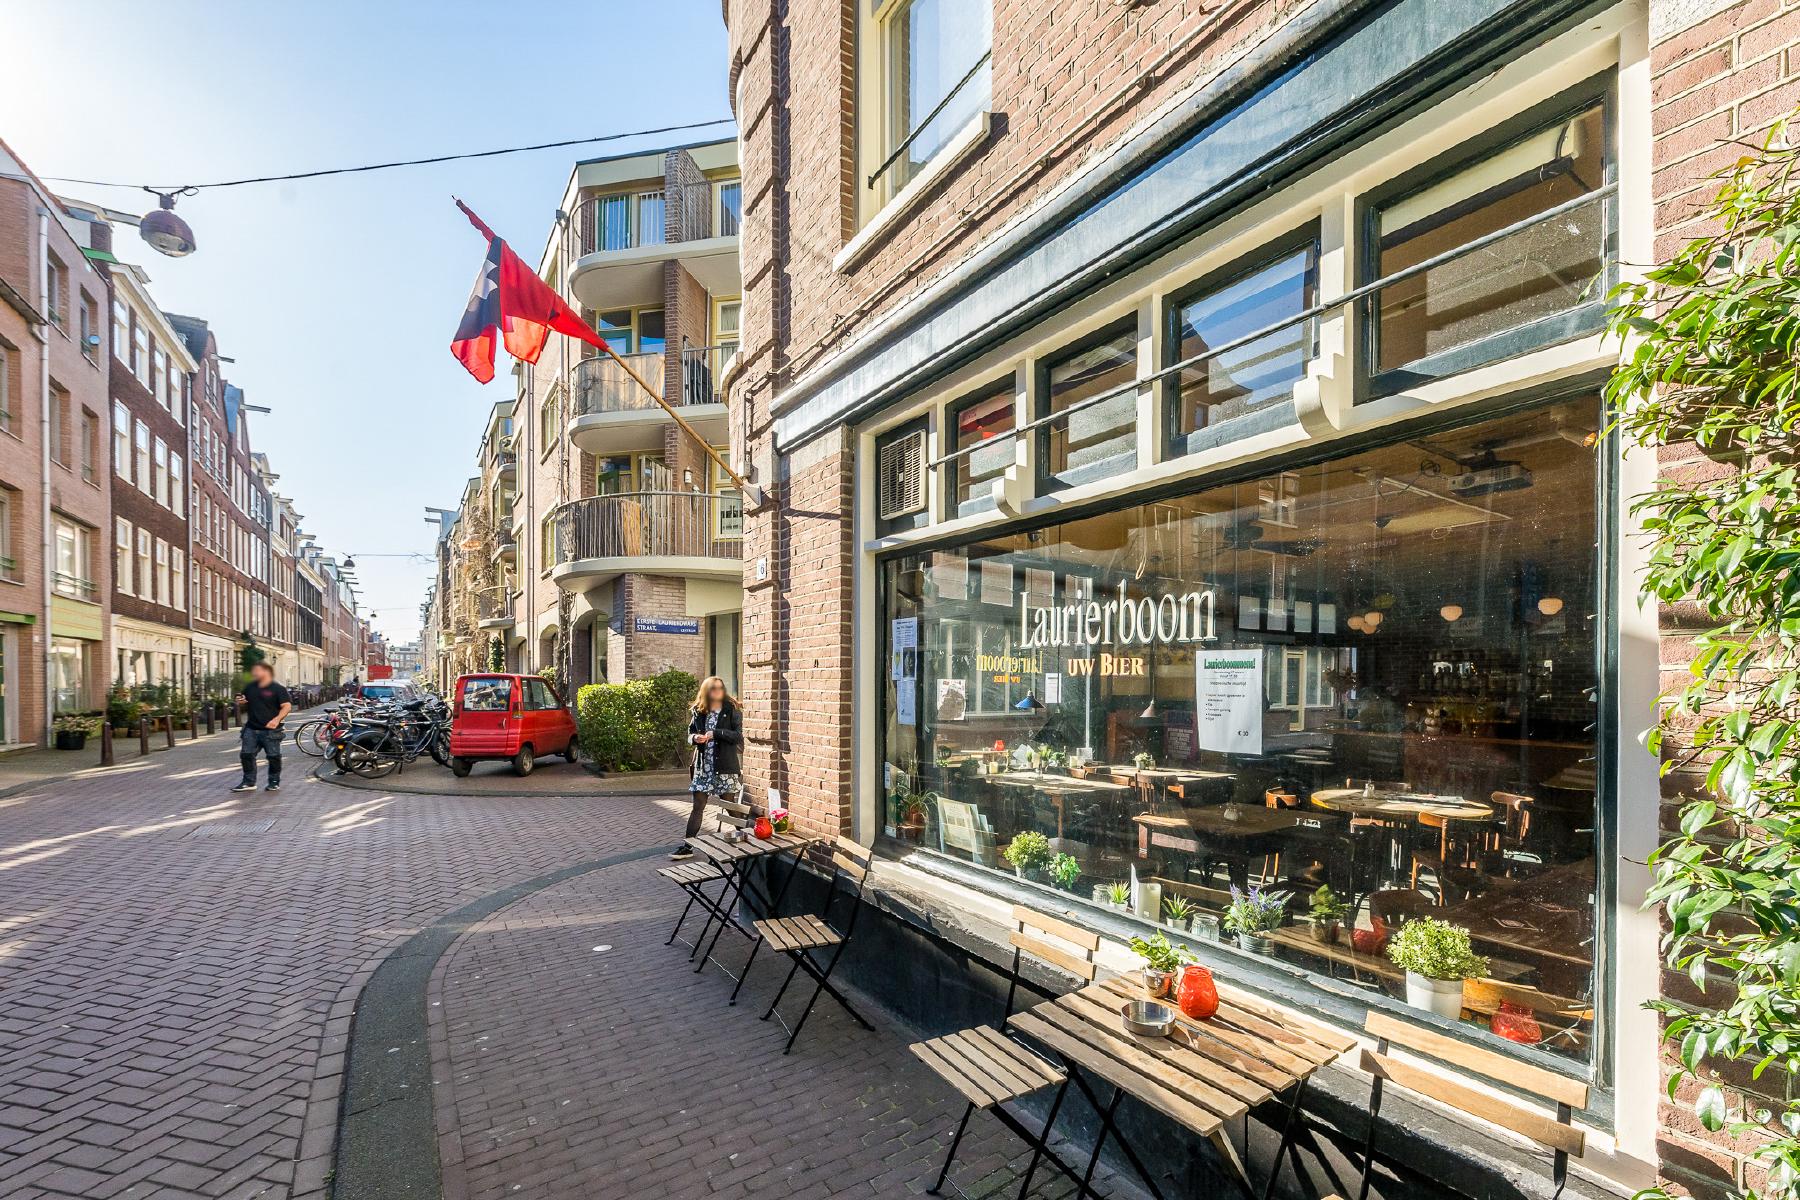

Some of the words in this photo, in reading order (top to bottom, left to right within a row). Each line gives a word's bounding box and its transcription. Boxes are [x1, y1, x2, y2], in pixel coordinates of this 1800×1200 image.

[636, 618, 655, 626] EERSTE
[1020, 578, 1218, 649] Laurierboom
[1100, 652, 1145, 677] BIER
